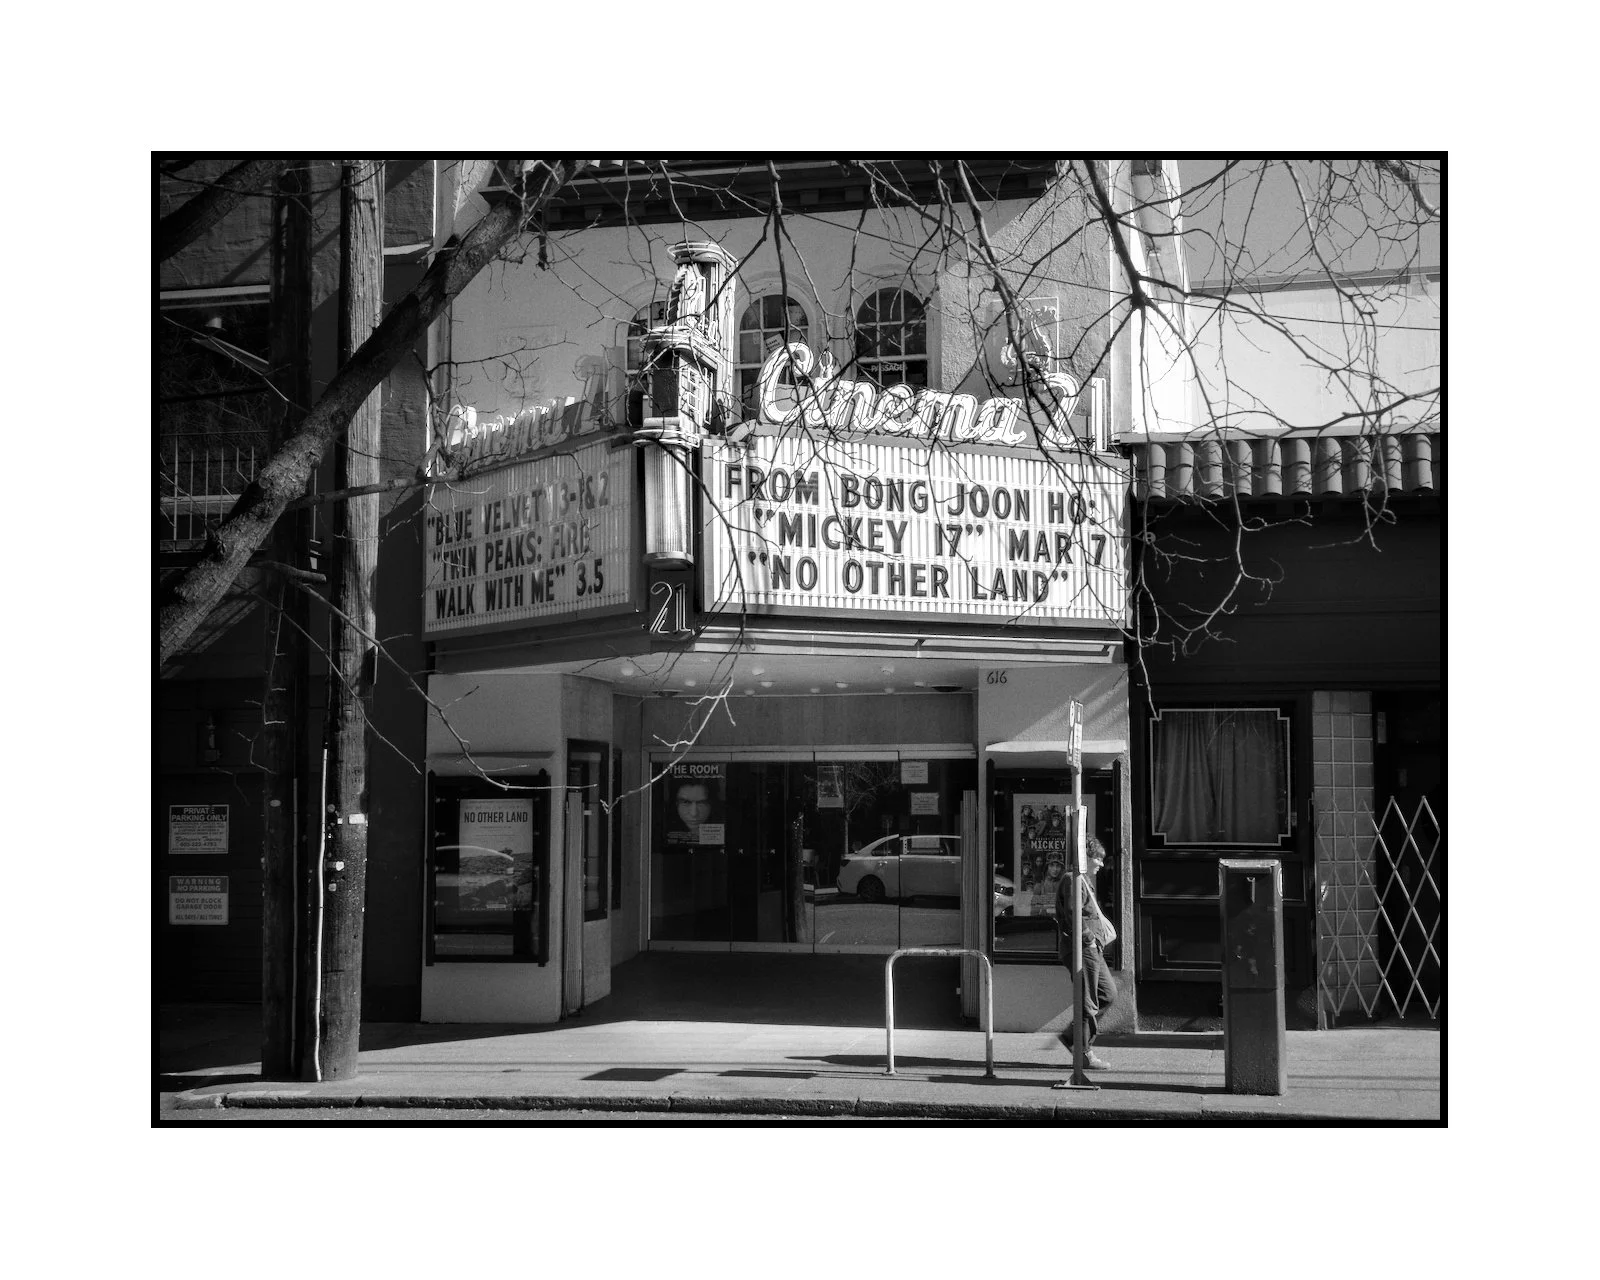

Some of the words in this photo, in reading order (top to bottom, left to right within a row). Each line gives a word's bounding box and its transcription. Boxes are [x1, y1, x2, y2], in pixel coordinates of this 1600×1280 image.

[758, 342, 1027, 444] Cinema
[1031, 372, 1107, 452] 21
[724, 463, 819, 506] FROM
[841, 473, 929, 514] BONG
[948, 483, 1030, 522] JOON
[1047, 491, 1096, 526] HO:
[427, 508, 472, 546] "BLUE
[754, 507, 908, 553] "MICKEY
[935, 523, 984, 557] 17"
[1008, 527, 1073, 565] MAR
[1091, 533, 1107, 566] 7
[432, 546, 477, 581] "TWIN
[485, 530, 542, 573] PEAKS:
[747, 551, 818, 591] "NO
[842, 558, 950, 599] OTHER
[971, 566, 1068, 603] LAND"
[435, 584, 475, 619] WALK
[485, 573, 524, 612] WITH
[531, 563, 565, 605] ME"
[576, 558, 604, 597] 3.5
[649, 581, 691, 634] 21
[986, 670, 1008, 684] 616
[669, 764, 687, 774] THE
[690, 764, 719, 774] ROOM
[464, 811, 475, 823] NO
[478, 811, 504, 823] OTHER
[506, 811, 528, 823] LAND
[1030, 840, 1066, 850] MICKEY
